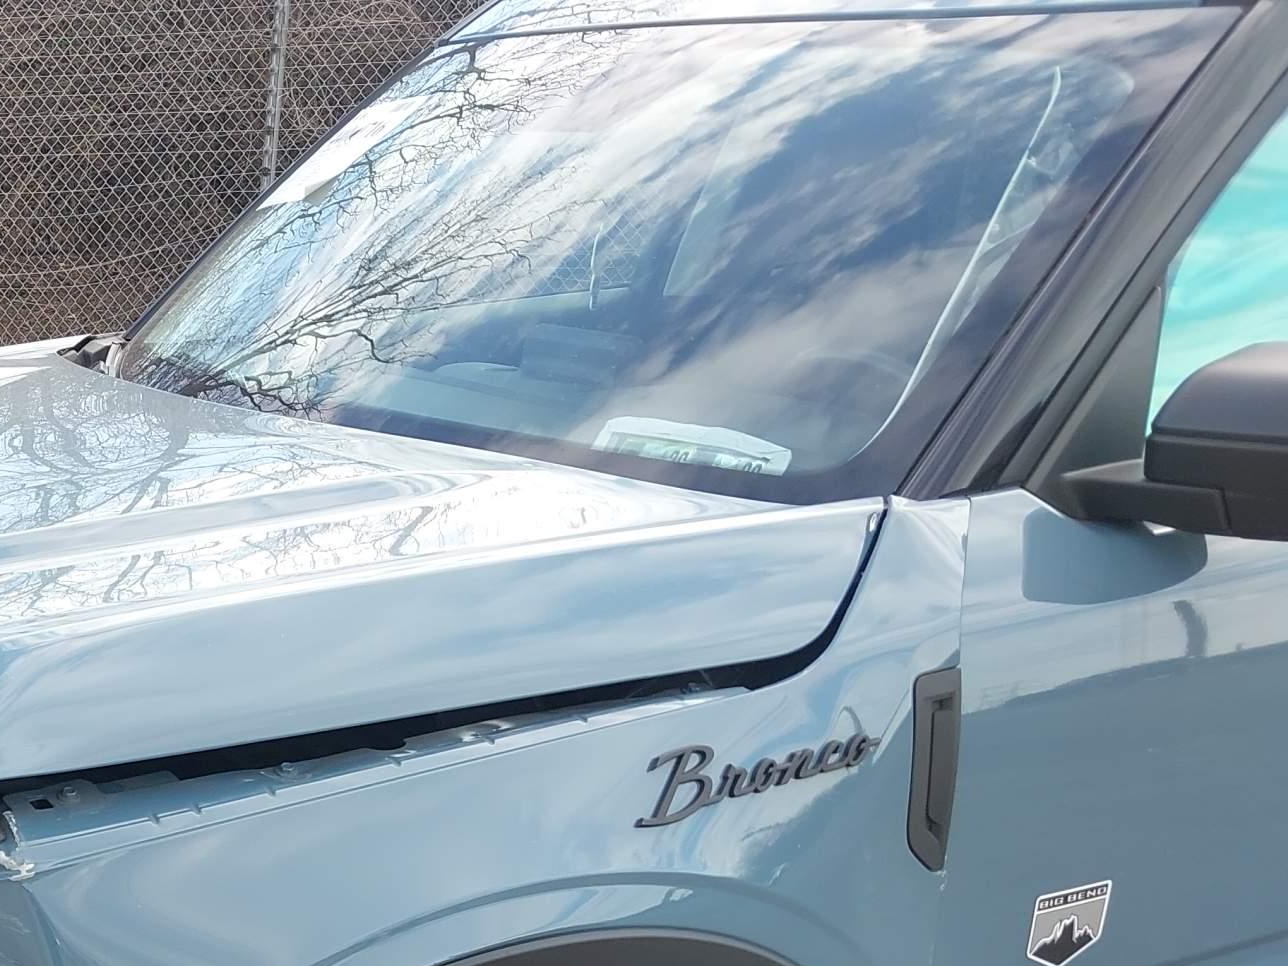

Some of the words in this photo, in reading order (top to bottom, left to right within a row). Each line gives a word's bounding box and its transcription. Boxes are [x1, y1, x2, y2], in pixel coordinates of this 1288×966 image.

[634, 733, 881, 828] Bronco
[1039, 897, 1064, 909] BIG
[1067, 886, 1107, 902] BEND
